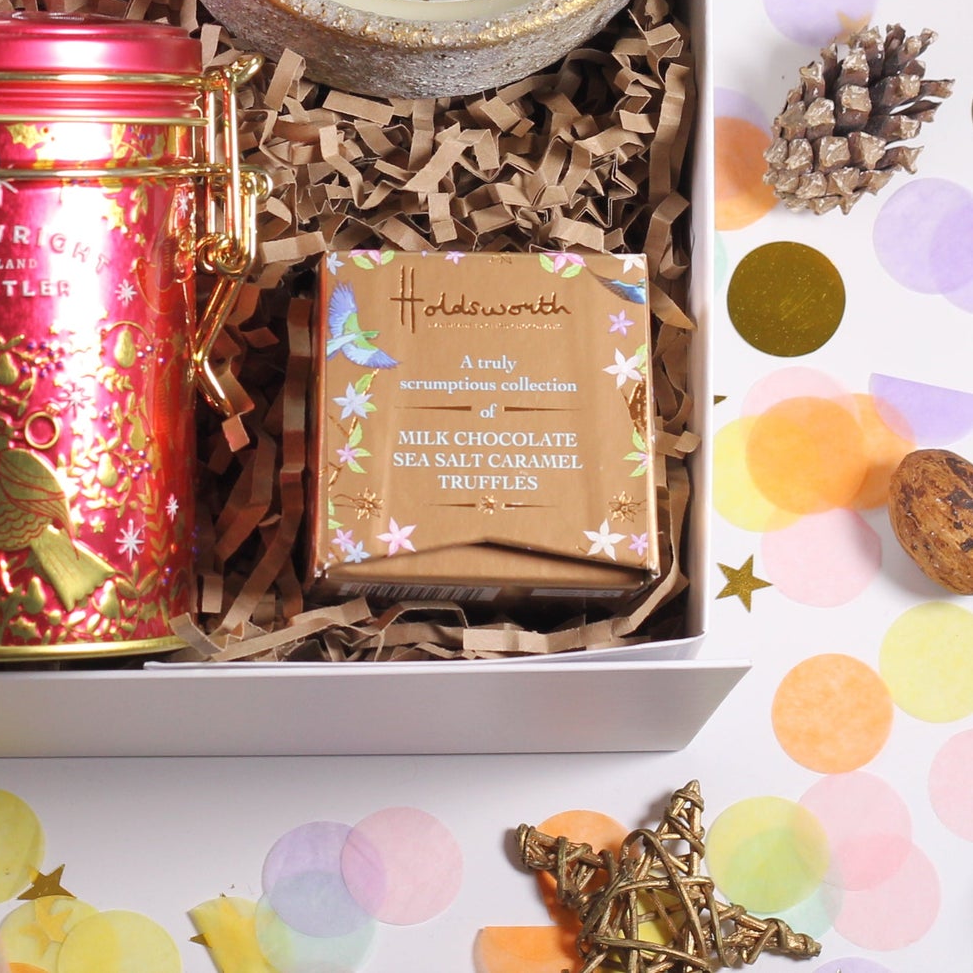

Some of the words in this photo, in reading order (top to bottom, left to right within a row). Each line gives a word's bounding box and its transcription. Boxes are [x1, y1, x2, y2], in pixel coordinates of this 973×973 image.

[390, 264, 572, 334] Holdsworth
[459, 355, 474, 370] A
[477, 355, 517, 374] truly
[398, 377, 497, 394] scrumptious
[500, 377, 578, 393] collection
[479, 402, 498, 418] of
[397, 431, 449, 446] MILK
[453, 431, 579, 448] CHOCOLATE
[392, 453, 429, 468] SEA
[434, 453, 482, 469] SALT
[487, 454, 584, 470] CARAMEL
[437, 474, 539, 491] TRUFFLES
